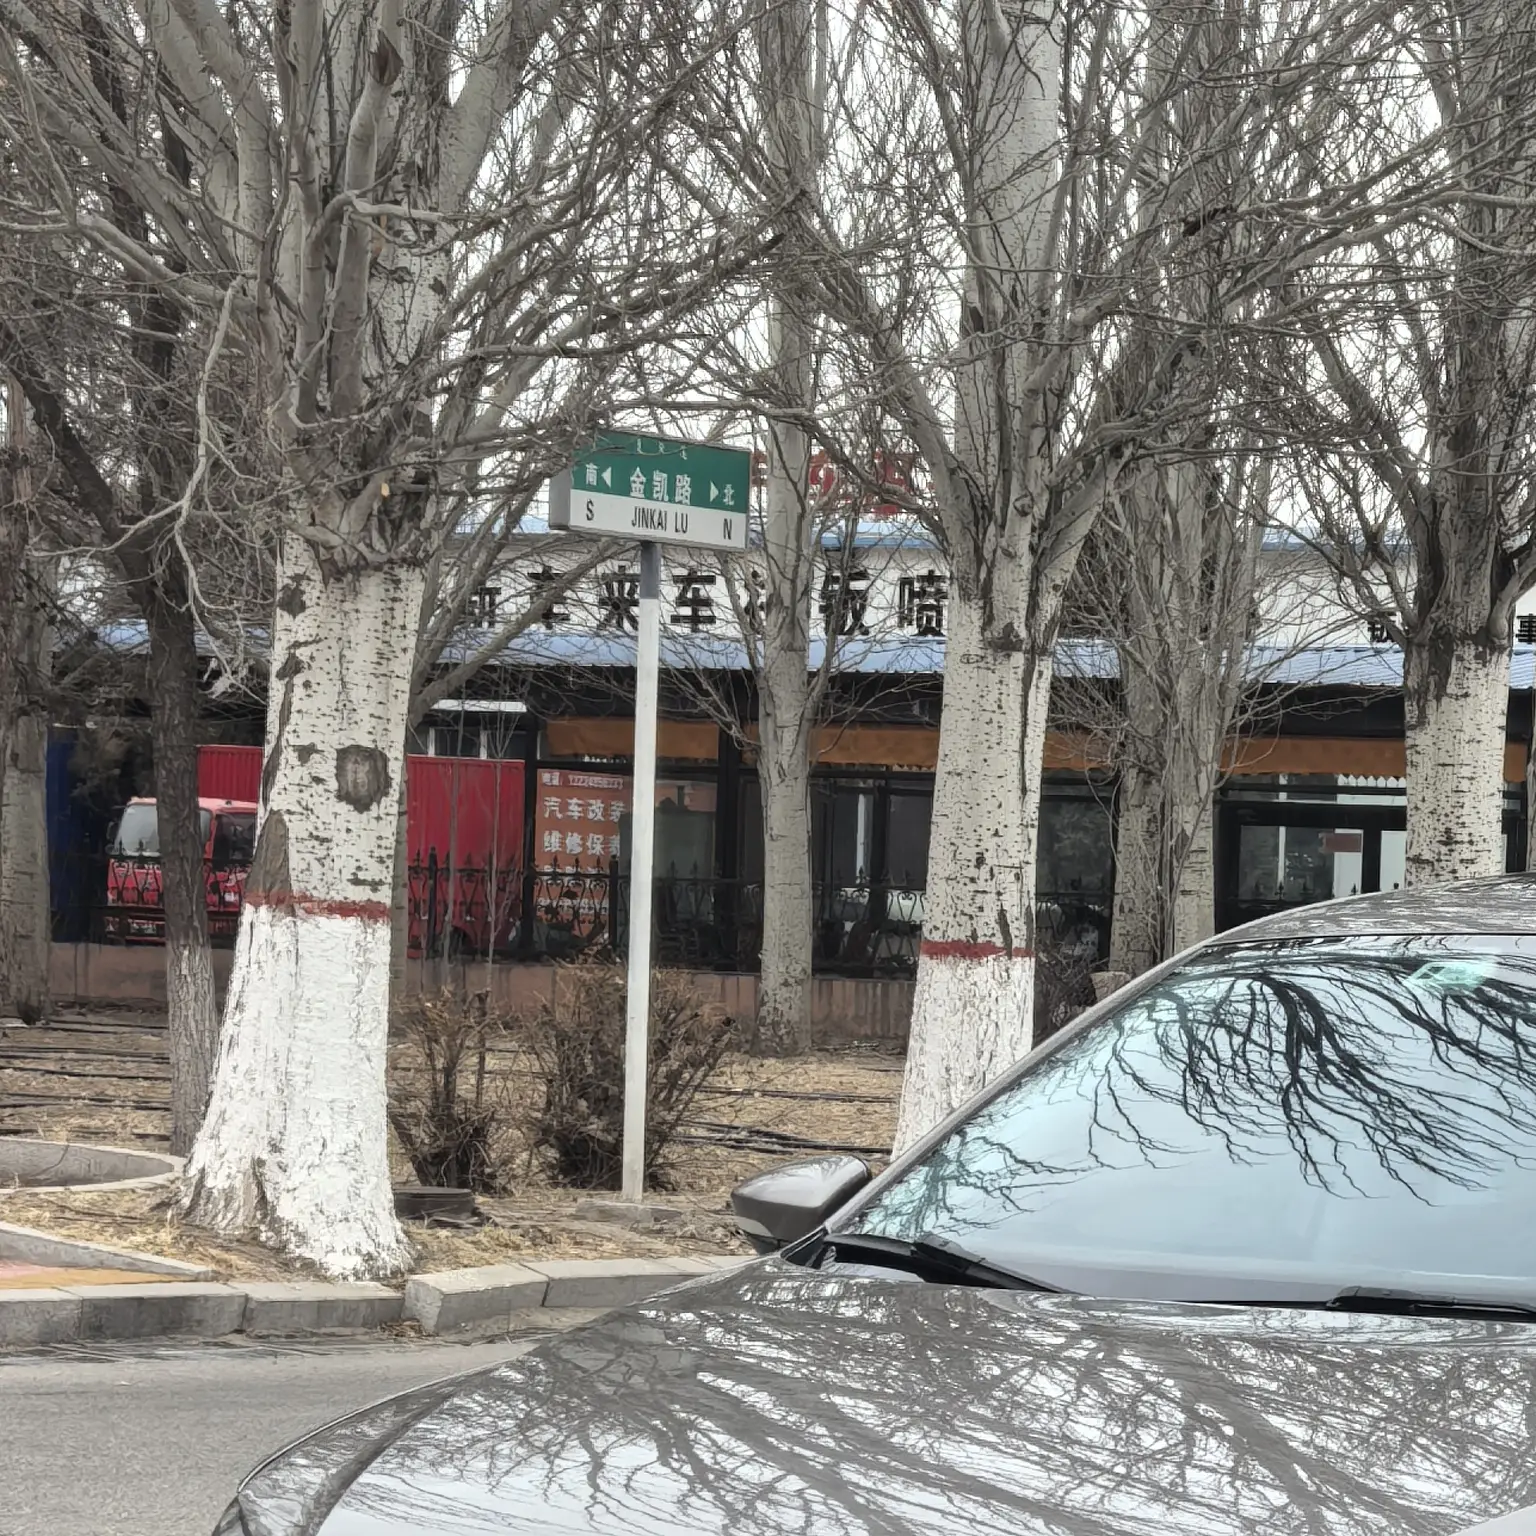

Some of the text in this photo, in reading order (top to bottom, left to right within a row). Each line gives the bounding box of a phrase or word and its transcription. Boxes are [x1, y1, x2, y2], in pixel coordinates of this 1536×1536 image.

[630, 466, 692, 506] 金凯路
[723, 483, 735, 506] 北
[586, 499, 733, 540] S JINKAI LU N
